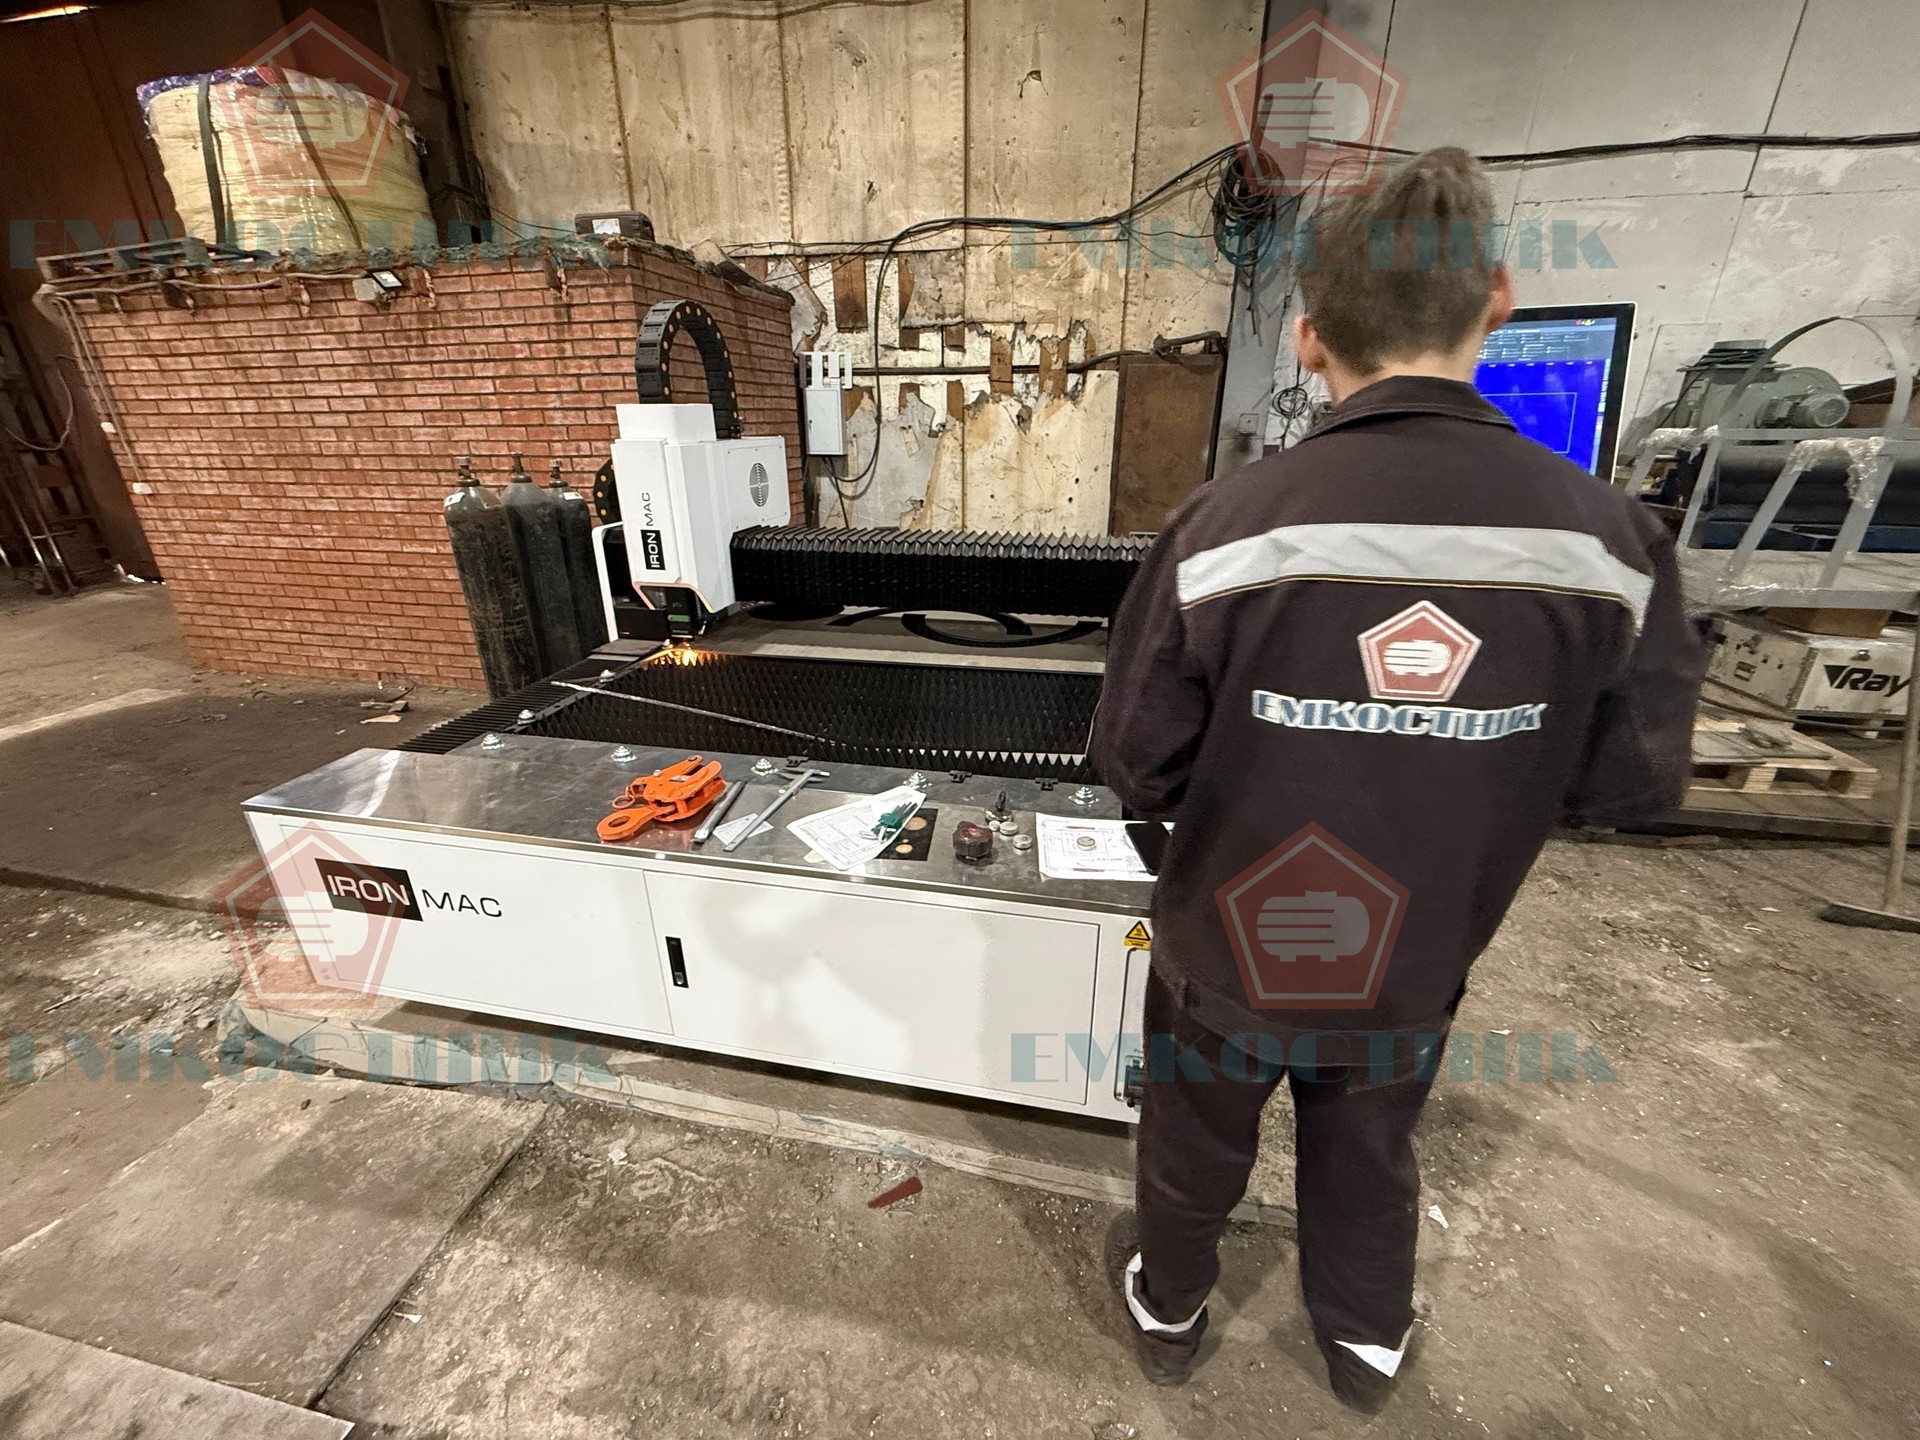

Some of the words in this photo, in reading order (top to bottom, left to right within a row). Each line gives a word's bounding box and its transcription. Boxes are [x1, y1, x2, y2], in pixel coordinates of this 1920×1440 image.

[642, 492, 654, 526] MAC
[647, 532, 660, 568] IRON
[1252, 689, 1545, 740] ЕМКОСТНИК
[326, 875, 410, 906] IRON
[421, 889, 502, 918] MAC
